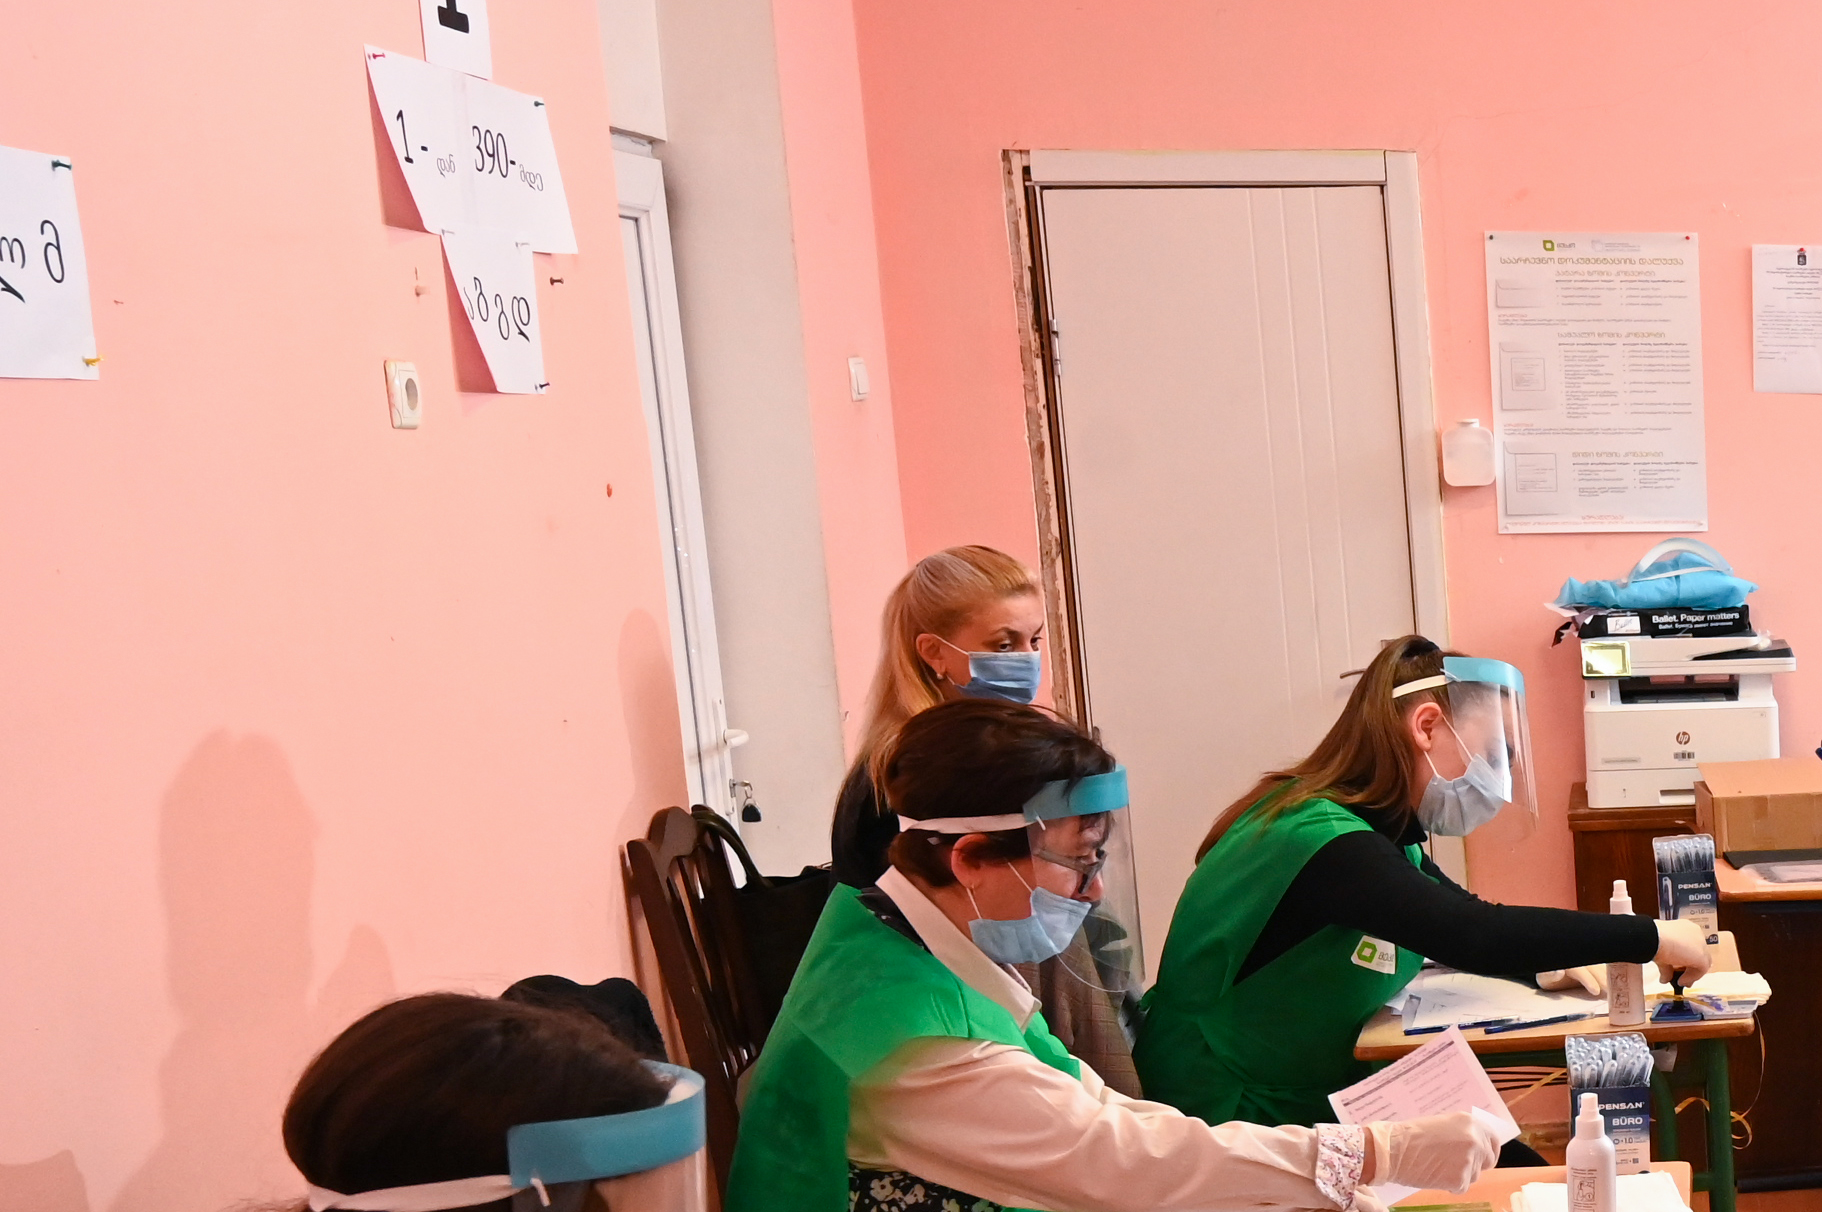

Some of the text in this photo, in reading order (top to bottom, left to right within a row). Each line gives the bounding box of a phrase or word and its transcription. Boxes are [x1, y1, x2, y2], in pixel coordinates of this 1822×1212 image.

[1680, 613, 1706, 623] Paper
[1707, 612, 1740, 621] matters
[1677, 731, 1690, 745] hp
[1677, 882, 1711, 890] PENSAN
[1688, 893, 1712, 901] BÜRO
[1612, 1117, 1643, 1126] BÜRO
